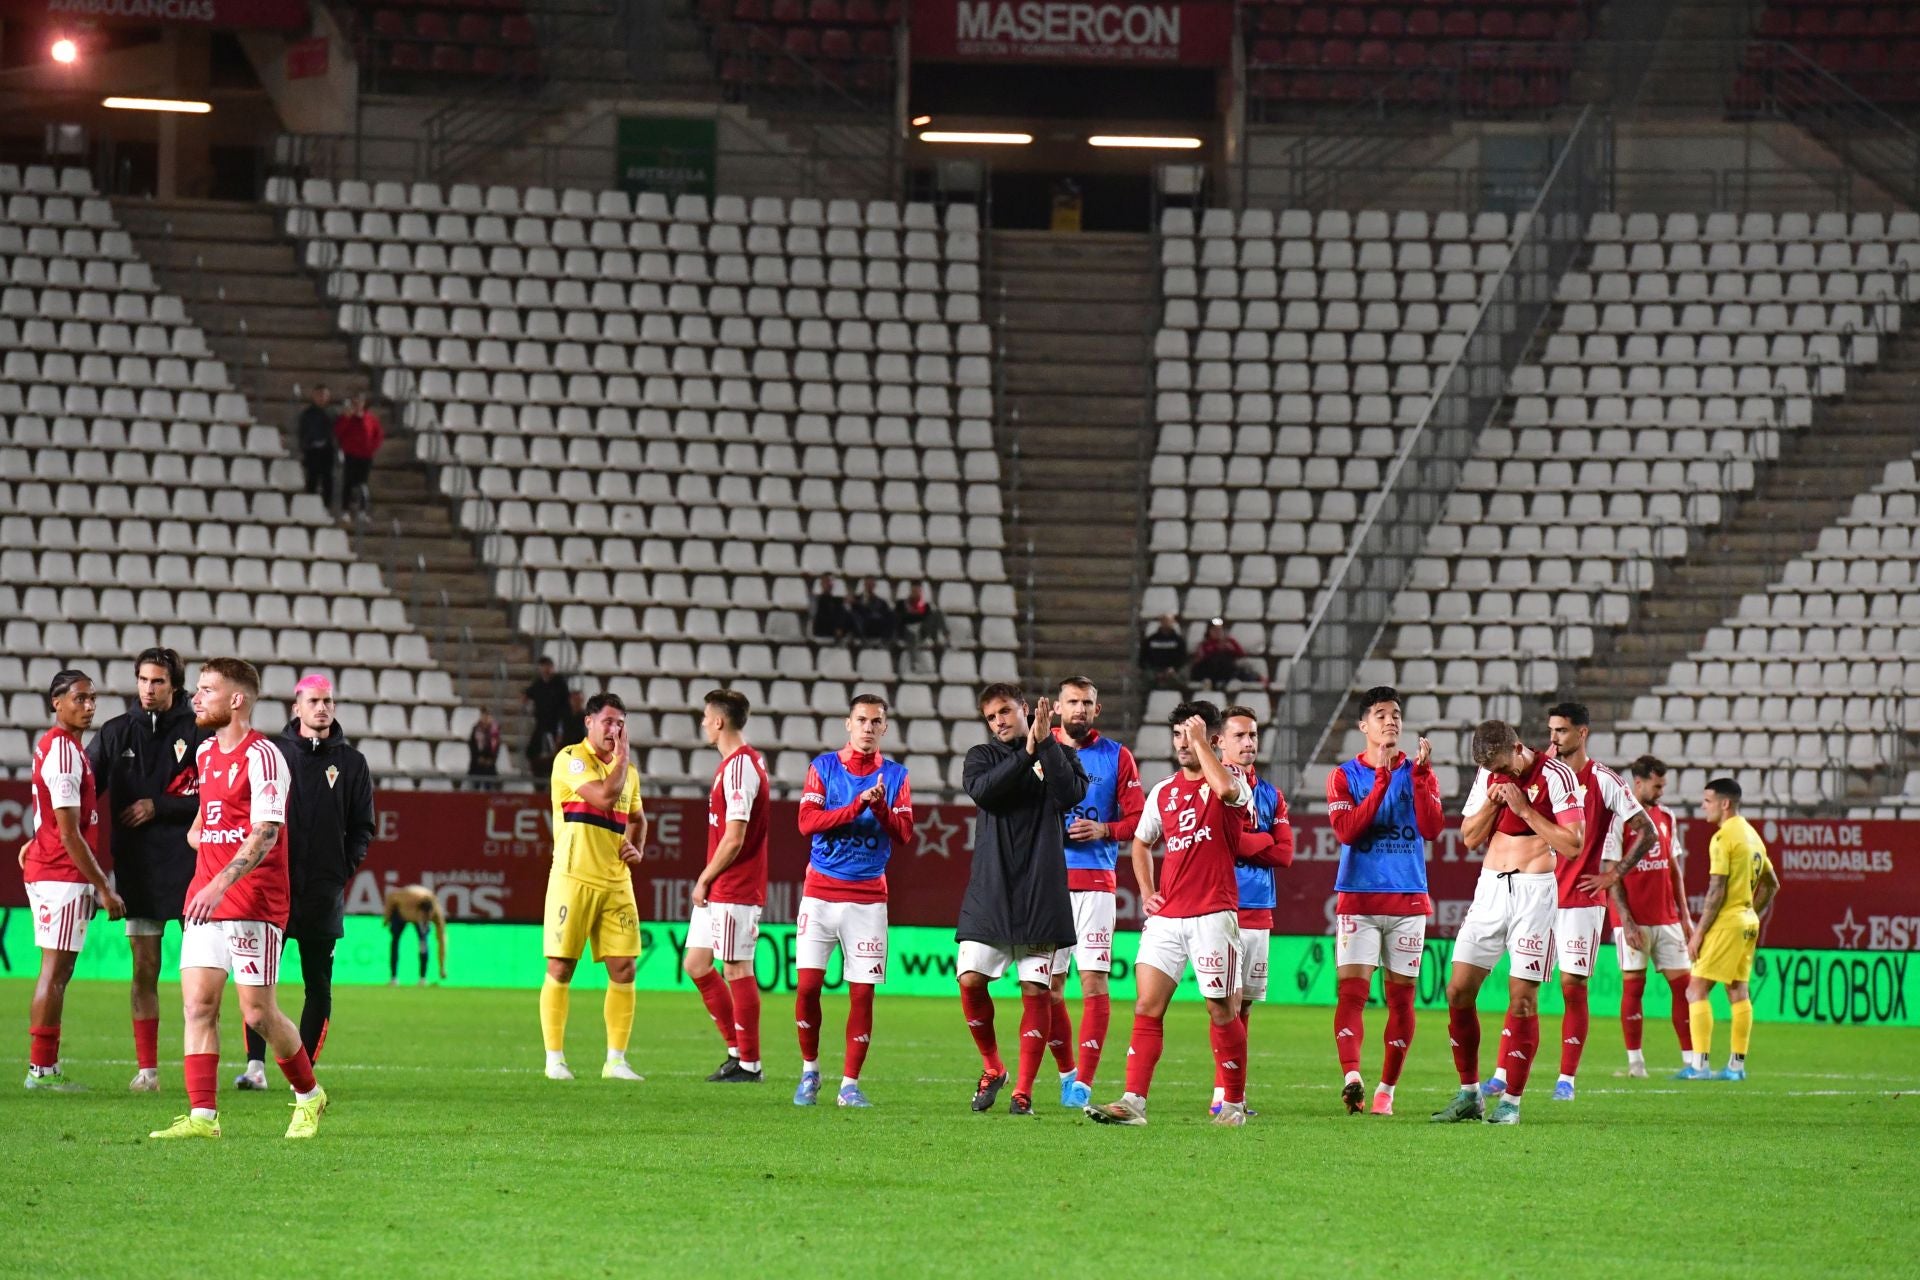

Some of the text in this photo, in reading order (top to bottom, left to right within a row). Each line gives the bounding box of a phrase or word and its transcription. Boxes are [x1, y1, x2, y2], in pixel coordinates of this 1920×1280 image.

[47, 0, 216, 20] AMBULANCIAS
[957, 2, 1181, 44] MASERCON
[1167, 826, 1212, 853] fibraet
[1780, 825, 1863, 847] VENTA DE
[1782, 851, 1894, 873] INOXIDABLES
[557, 905, 569, 926] 9
[229, 936, 259, 950] CRC
[1087, 933, 1111, 943] CRC
[1399, 936, 1422, 947] CRC
[1518, 937, 1543, 951] CRC
[1566, 939, 1587, 950] CRC
[857, 942, 884, 952] CRC
[1197, 956, 1224, 968] CRC
